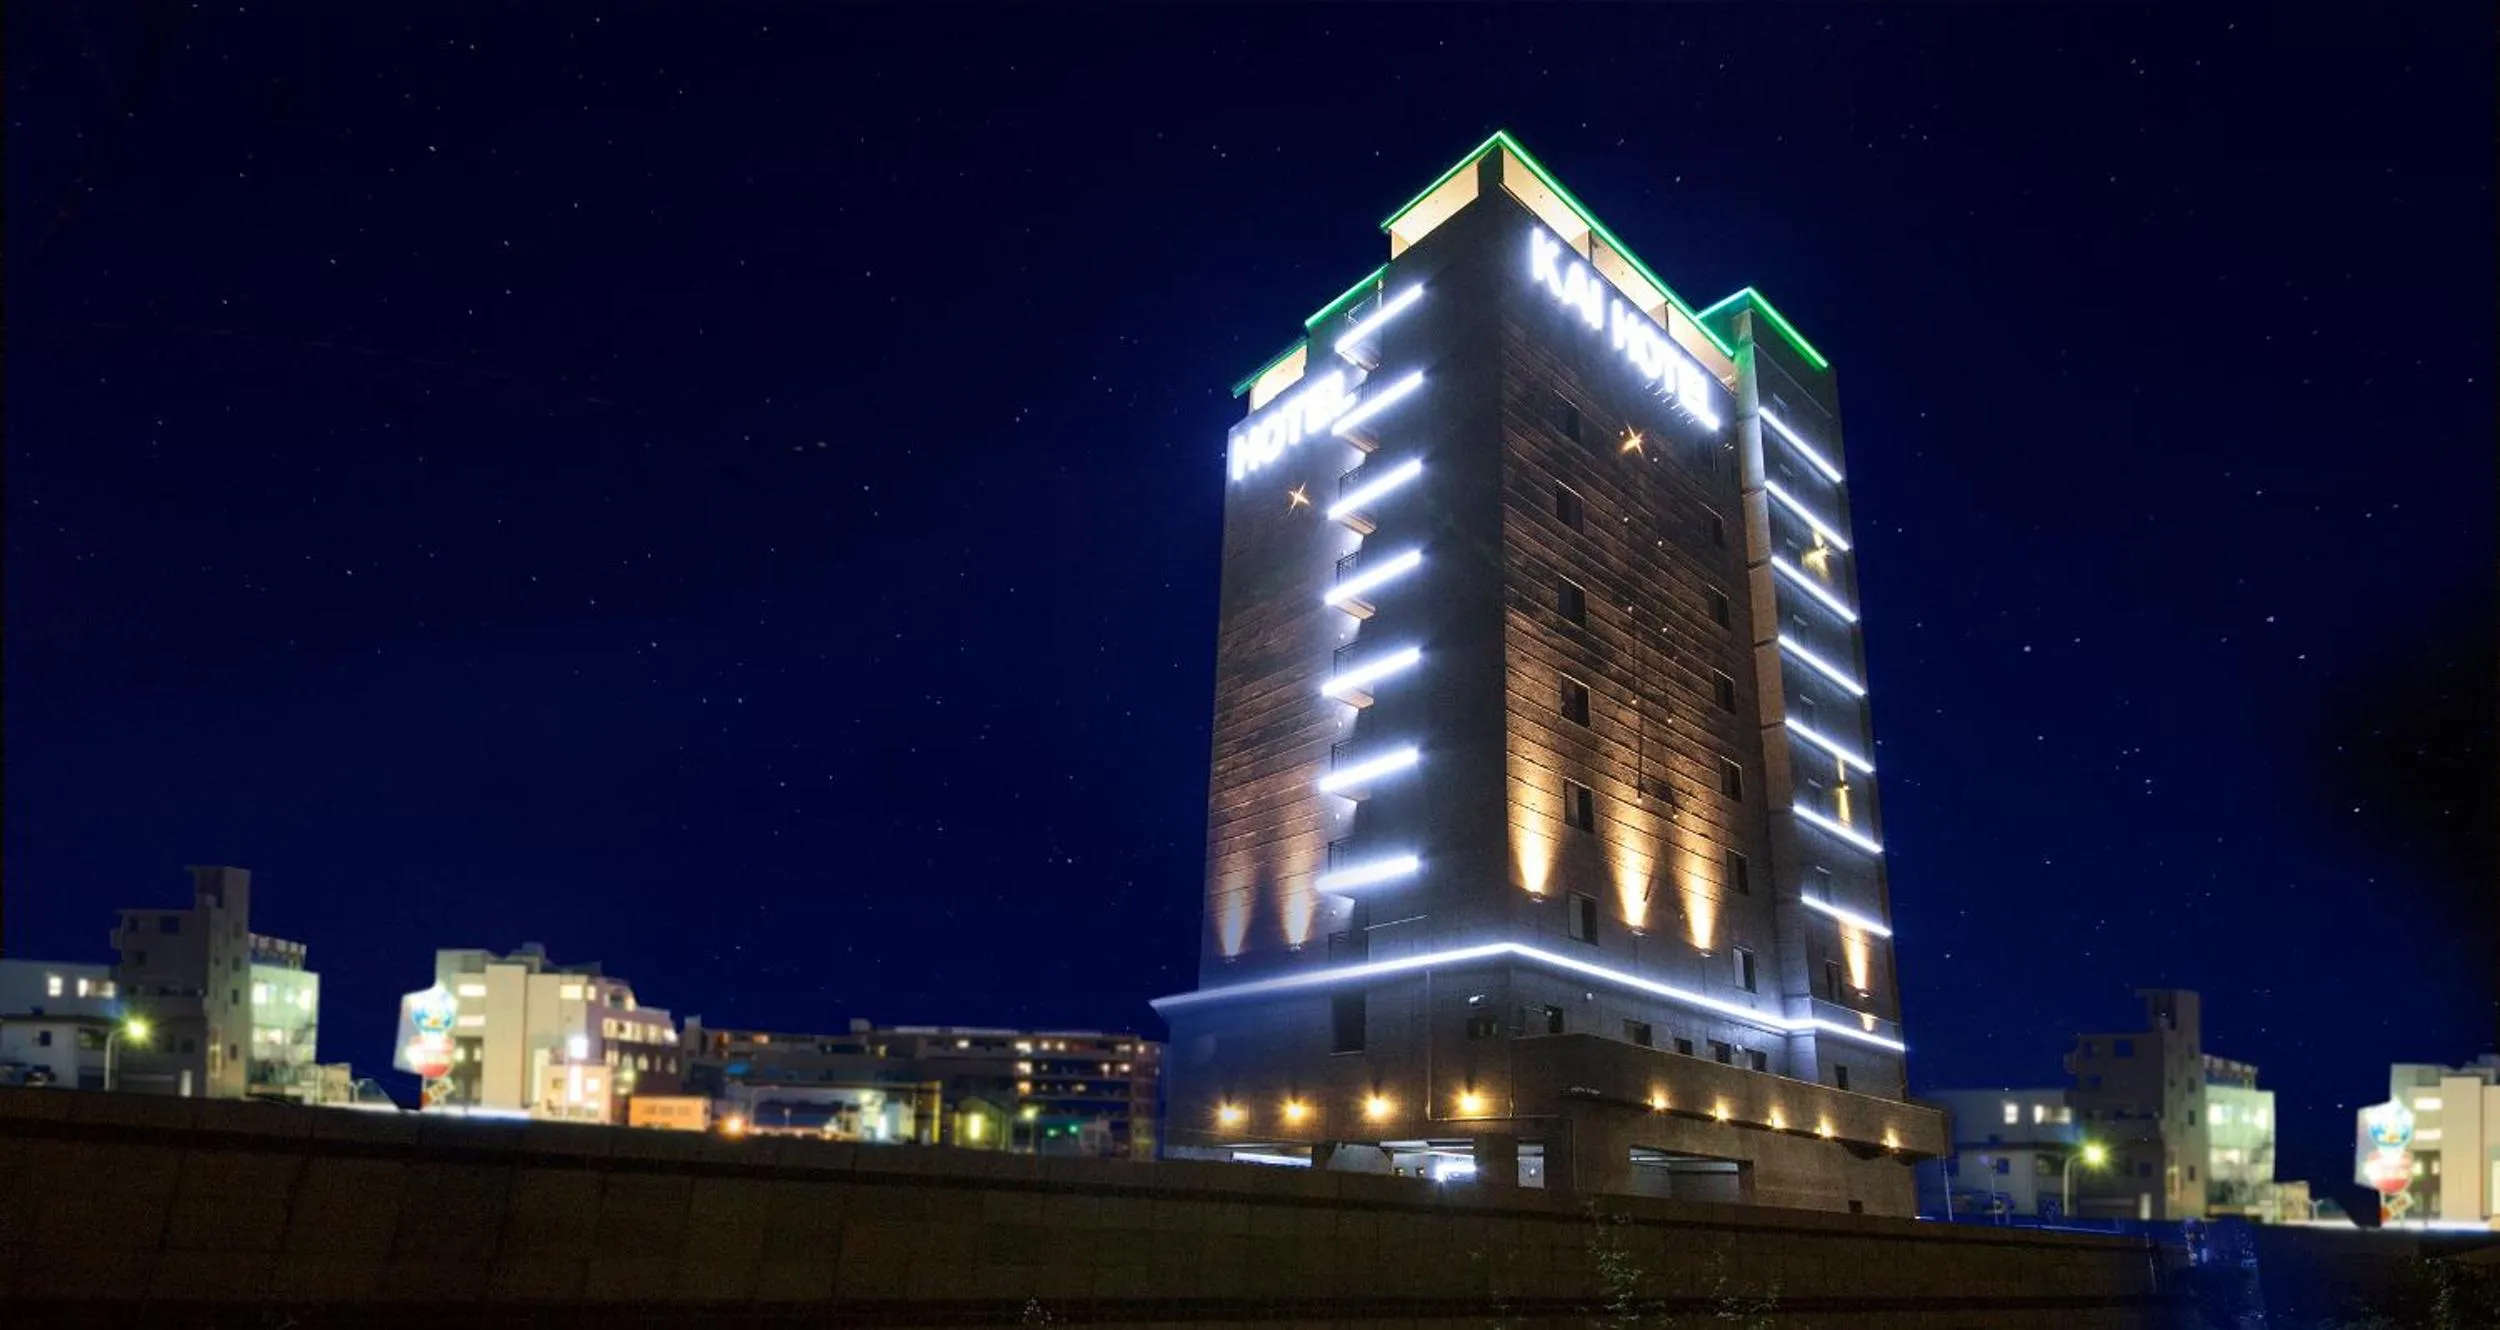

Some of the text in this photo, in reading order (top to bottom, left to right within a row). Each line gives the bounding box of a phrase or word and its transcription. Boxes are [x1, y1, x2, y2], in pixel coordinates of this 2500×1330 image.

[1530, 227, 1720, 431] KAI HOTEL
[1231, 371, 1356, 481] HOTEL
